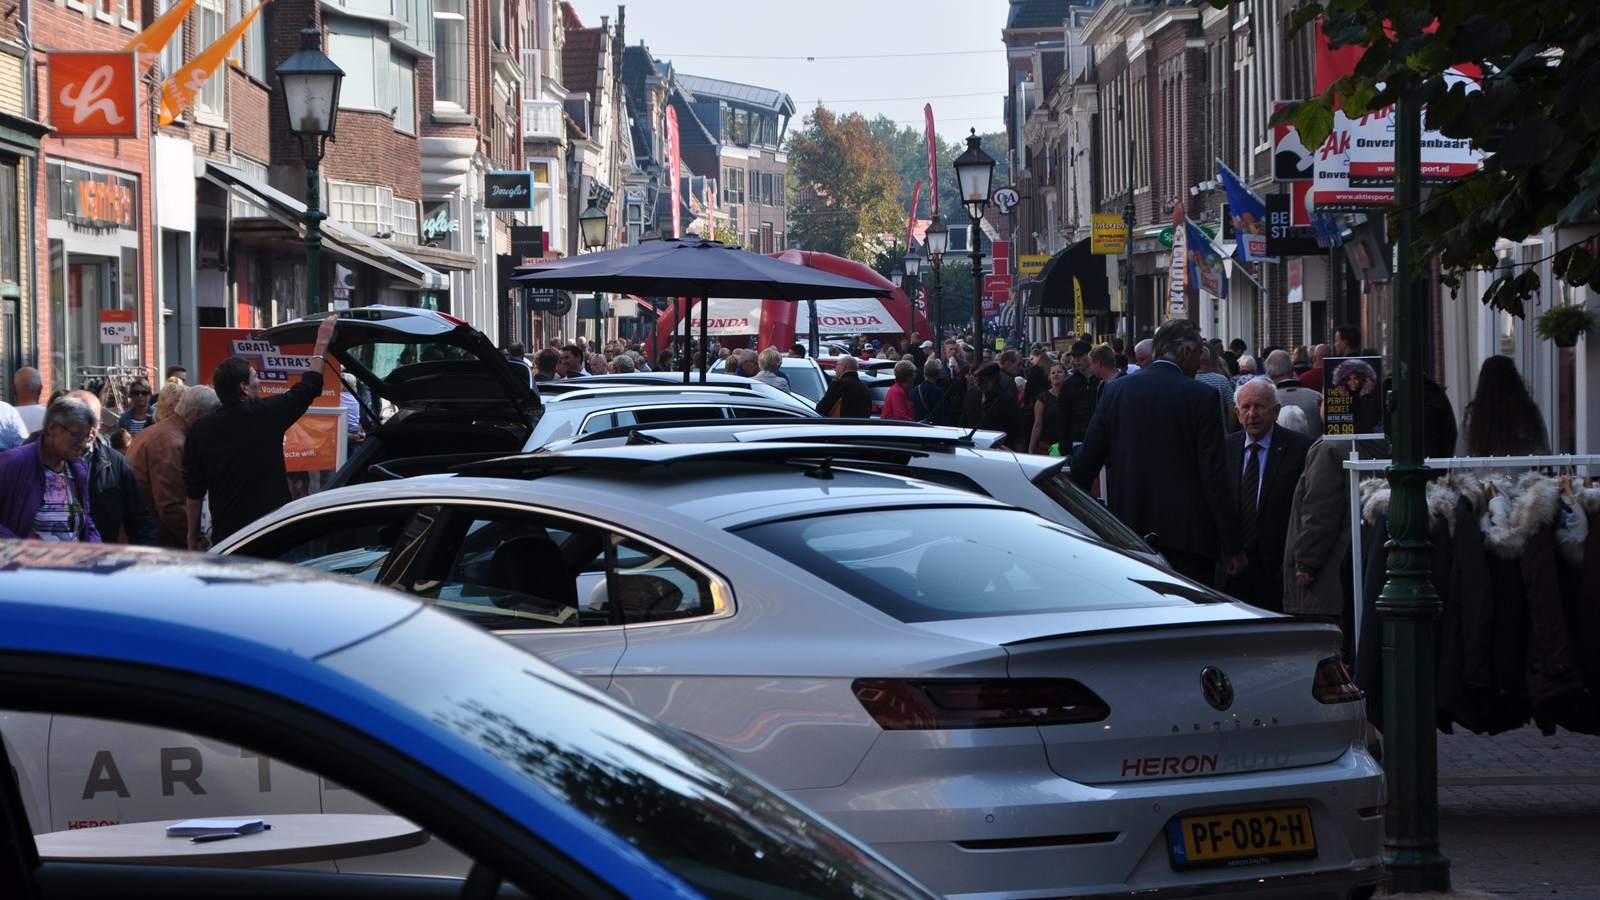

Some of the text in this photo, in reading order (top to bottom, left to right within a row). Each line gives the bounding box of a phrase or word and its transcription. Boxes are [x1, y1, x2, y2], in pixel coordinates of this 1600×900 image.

[1356, 138, 1473, 149] Onveranbaar
[1318, 170, 1350, 179] Onve
[1336, 193, 1395, 201] www.aktiesport.n
[1271, 211, 1289, 224] BE
[1271, 226, 1289, 238] ST
[691, 317, 750, 328] HONDA
[238, 342, 277, 352] GRATIS
[268, 357, 311, 367] EXTRA'S
[1328, 396, 1353, 405] PERFECT
[1328, 423, 1354, 435] 29.99
[1121, 754, 1218, 777] HERON
[1191, 814, 1305, 854] PF-082-H
